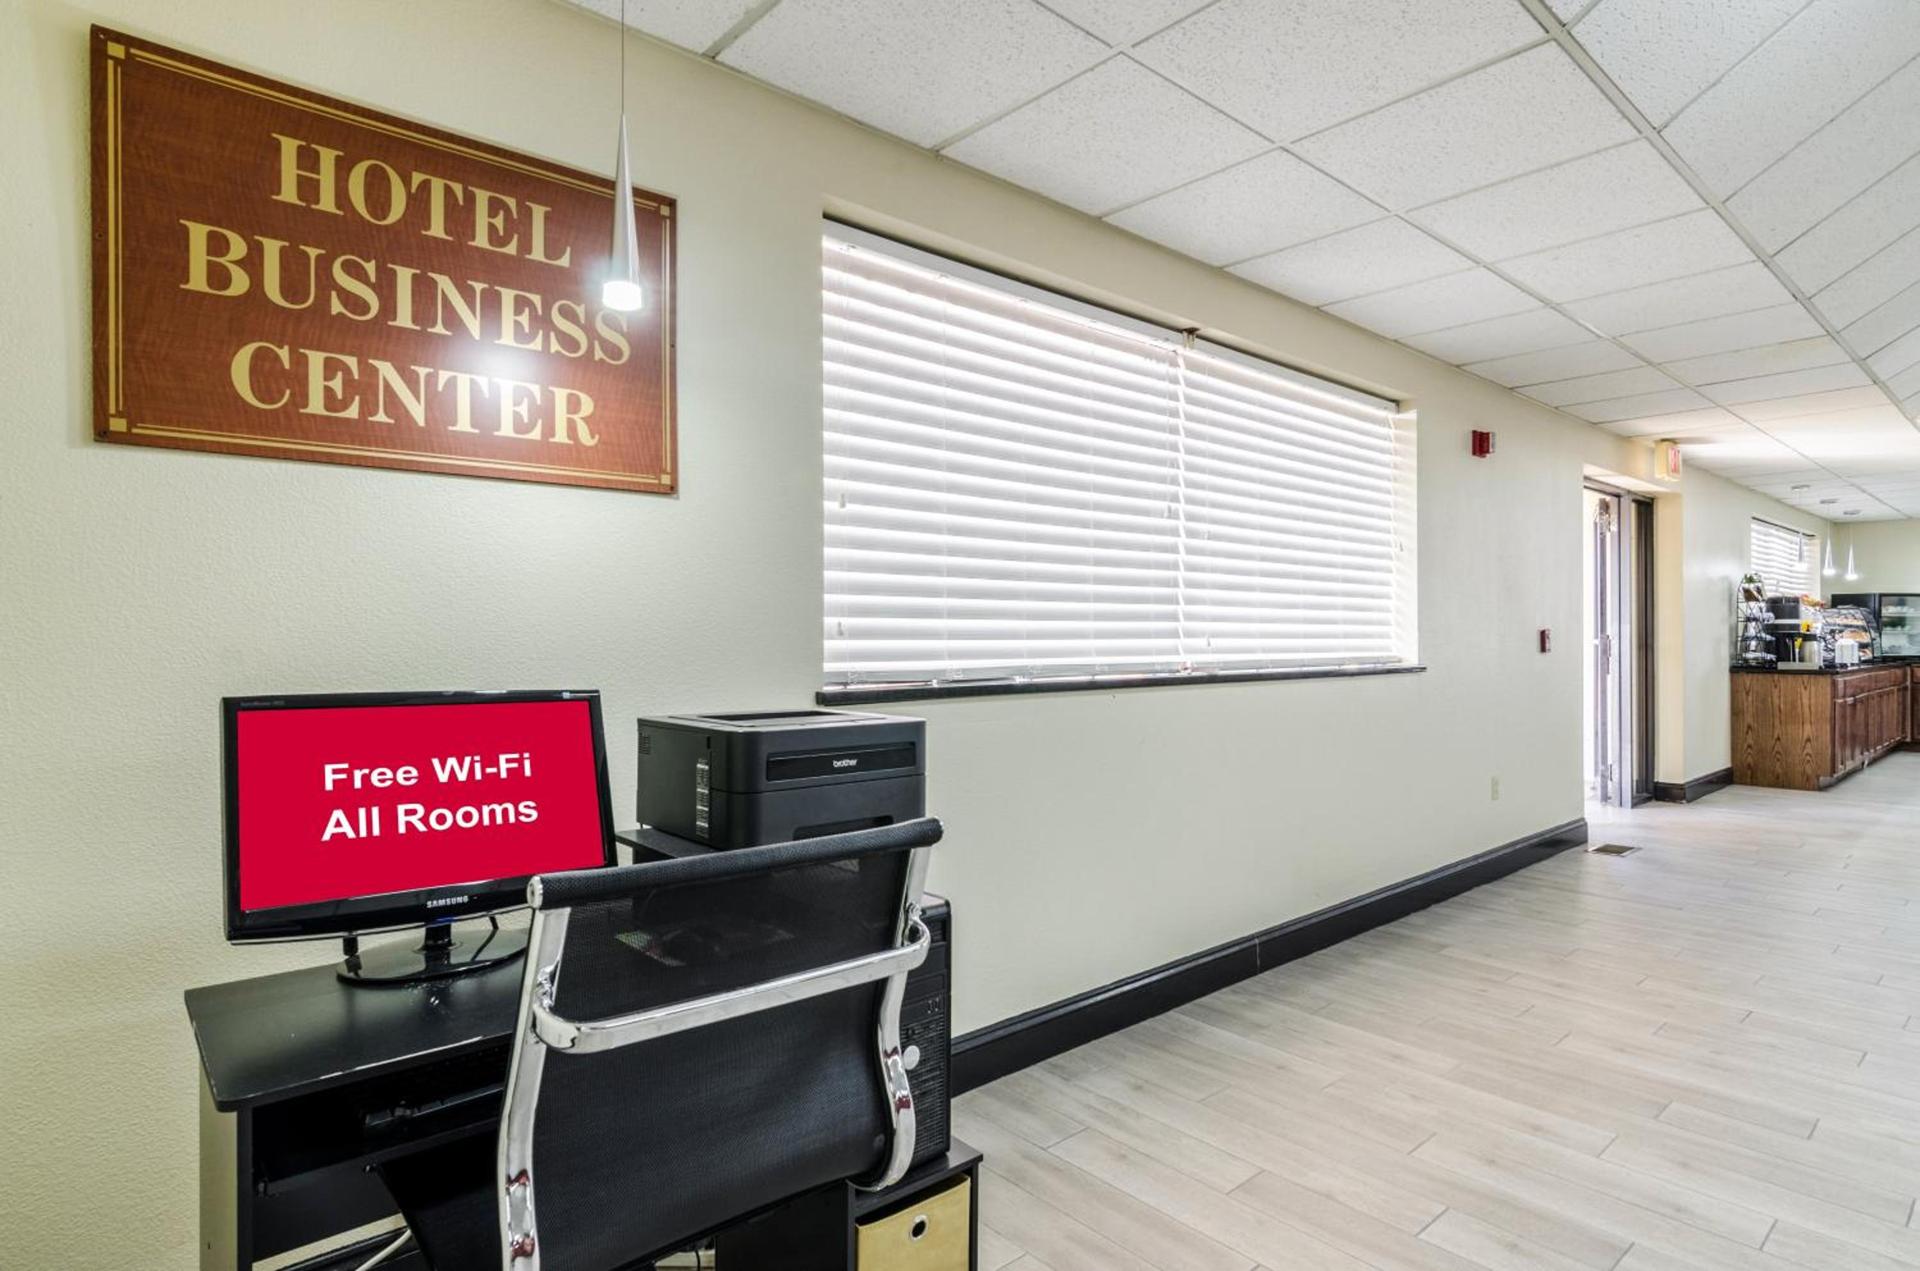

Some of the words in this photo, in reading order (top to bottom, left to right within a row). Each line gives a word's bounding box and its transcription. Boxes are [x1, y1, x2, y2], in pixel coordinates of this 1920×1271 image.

[271, 132, 572, 268] HOTEL
[178, 218, 631, 365] BUSINESS
[230, 341, 599, 447] CENTER
[323, 762, 419, 791] Free
[431, 752, 532, 783] Wi-Fi
[832, 758, 858, 768] brother
[321, 805, 380, 842] All
[397, 800, 539, 834] Rooms
[426, 895, 469, 909] SAMSUNG
